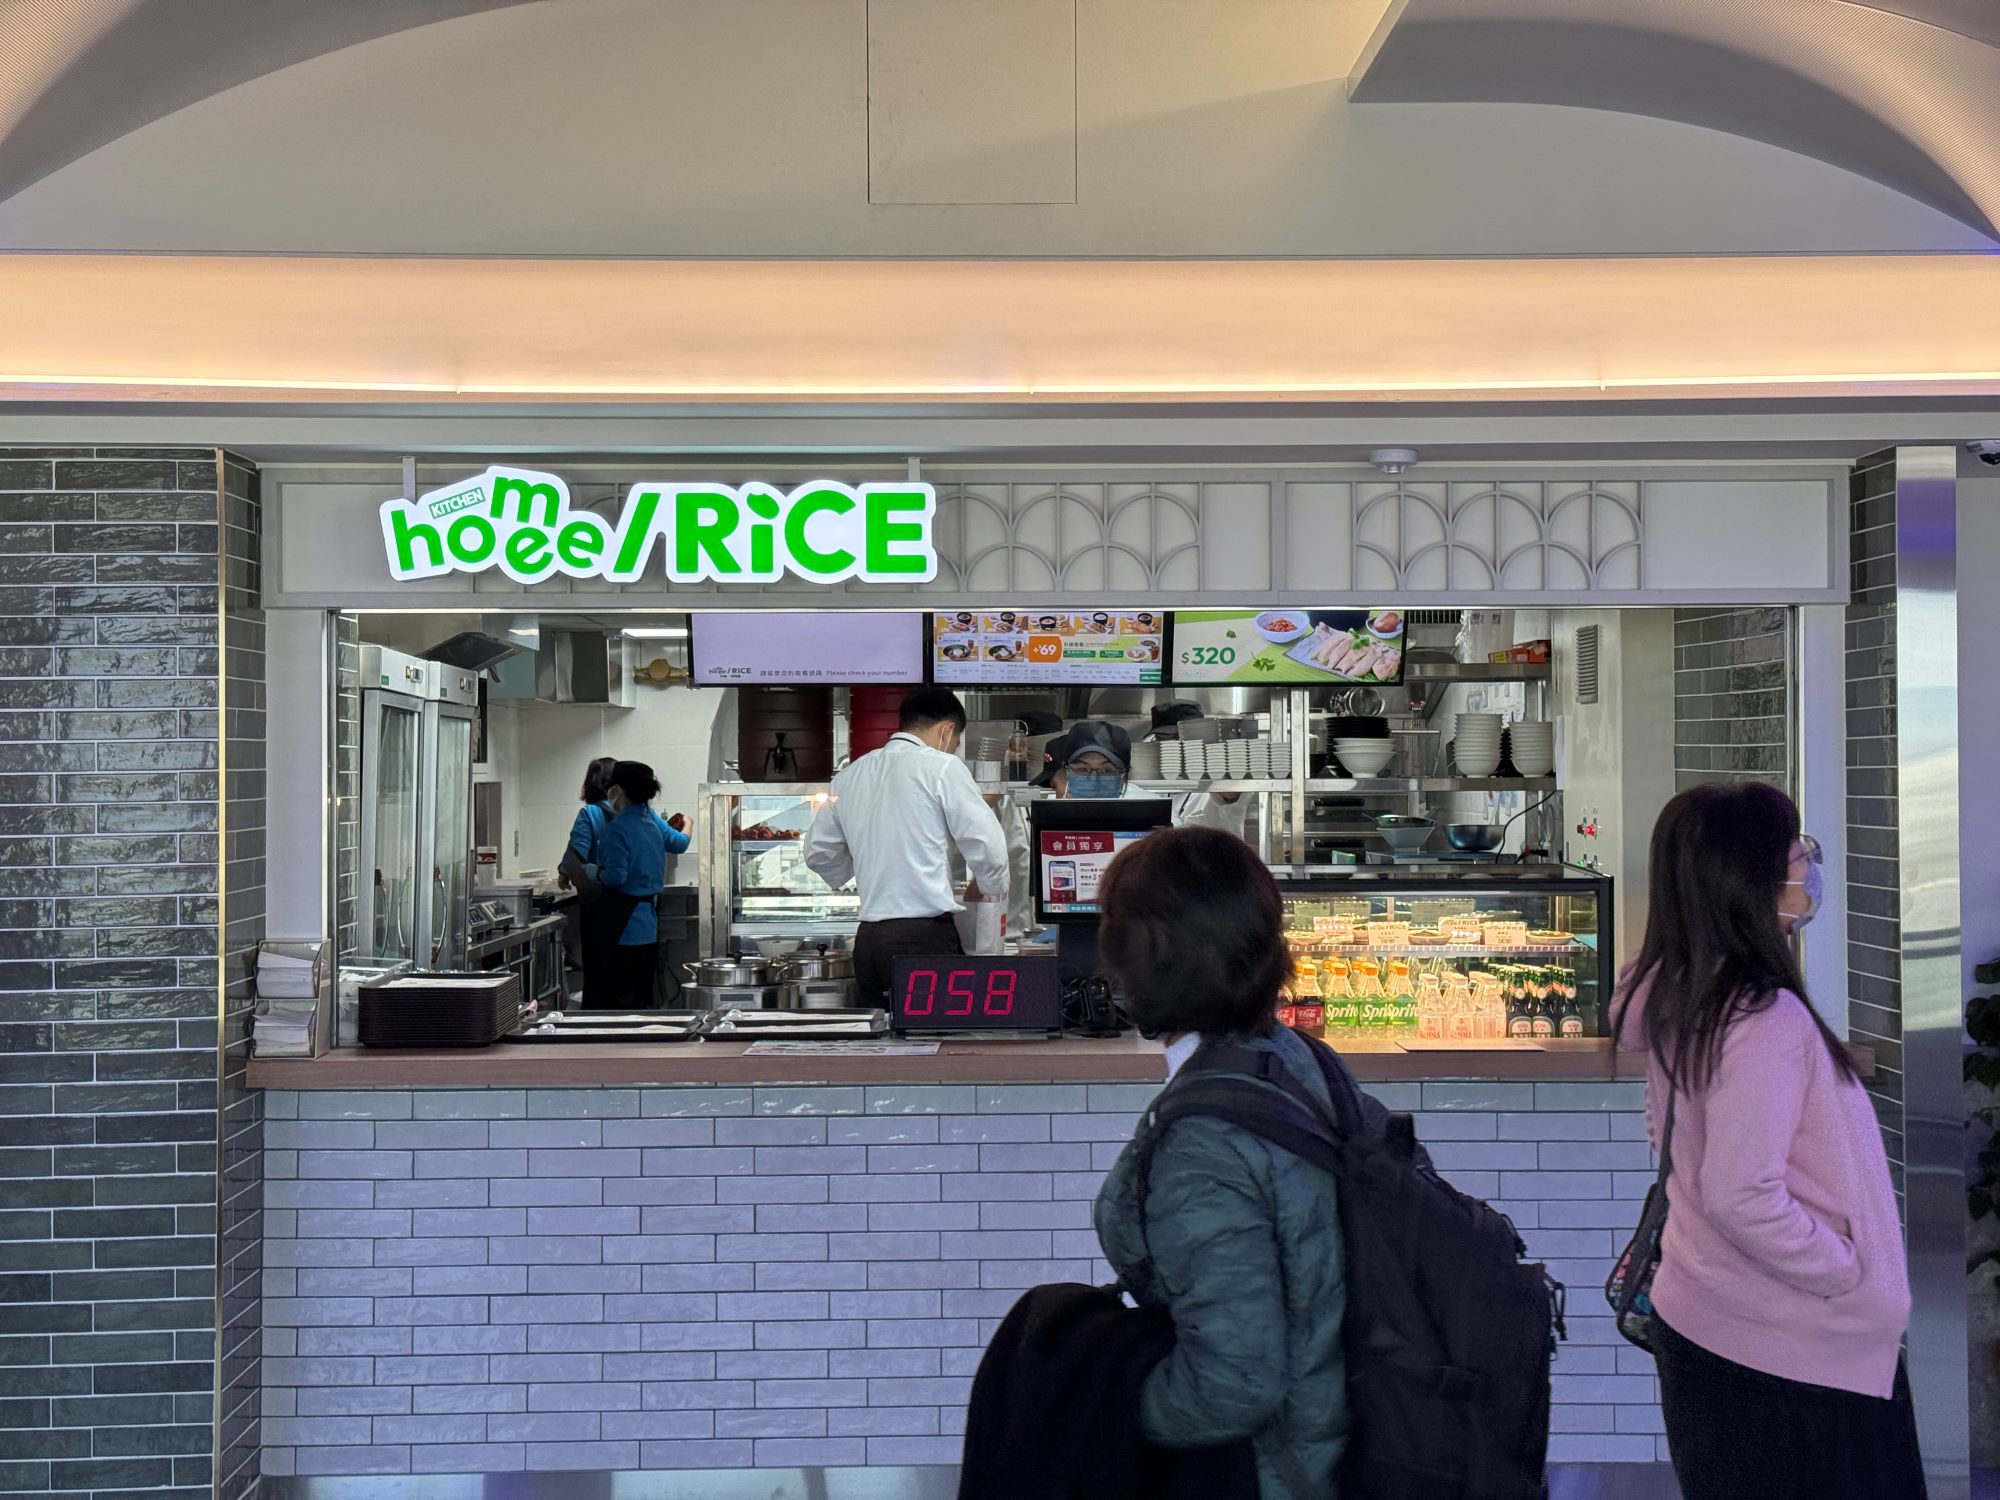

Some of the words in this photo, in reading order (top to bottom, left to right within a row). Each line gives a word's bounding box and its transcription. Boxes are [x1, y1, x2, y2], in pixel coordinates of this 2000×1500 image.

[430, 488, 484, 517] KITCHEN
[1181, 646, 1236, 665] $320
[867, 670, 882, 678] your
[1052, 841, 1104, 851] 會員獨享
[903, 970, 1018, 1016] 058
